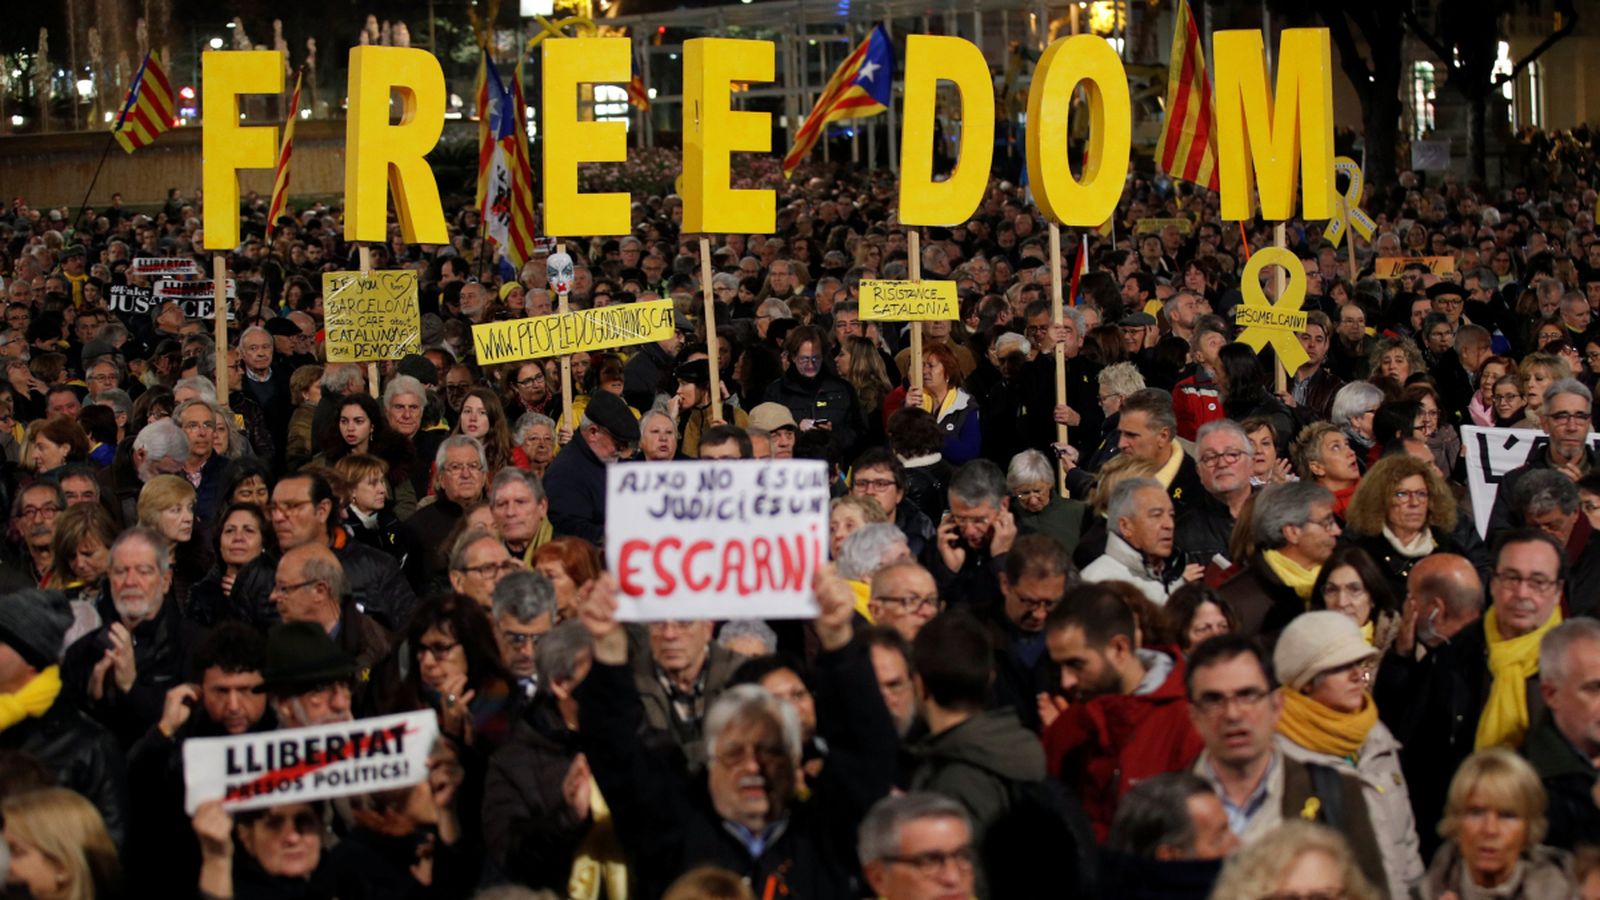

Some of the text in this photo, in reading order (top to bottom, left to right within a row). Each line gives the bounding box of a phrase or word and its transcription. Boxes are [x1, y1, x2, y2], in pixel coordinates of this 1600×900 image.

[202, 28, 1335, 250] FREEDOM
[110, 285, 150, 296] #Fake
[698, 468, 733, 491] NO
[225, 724, 408, 776] LLIBERTAT
